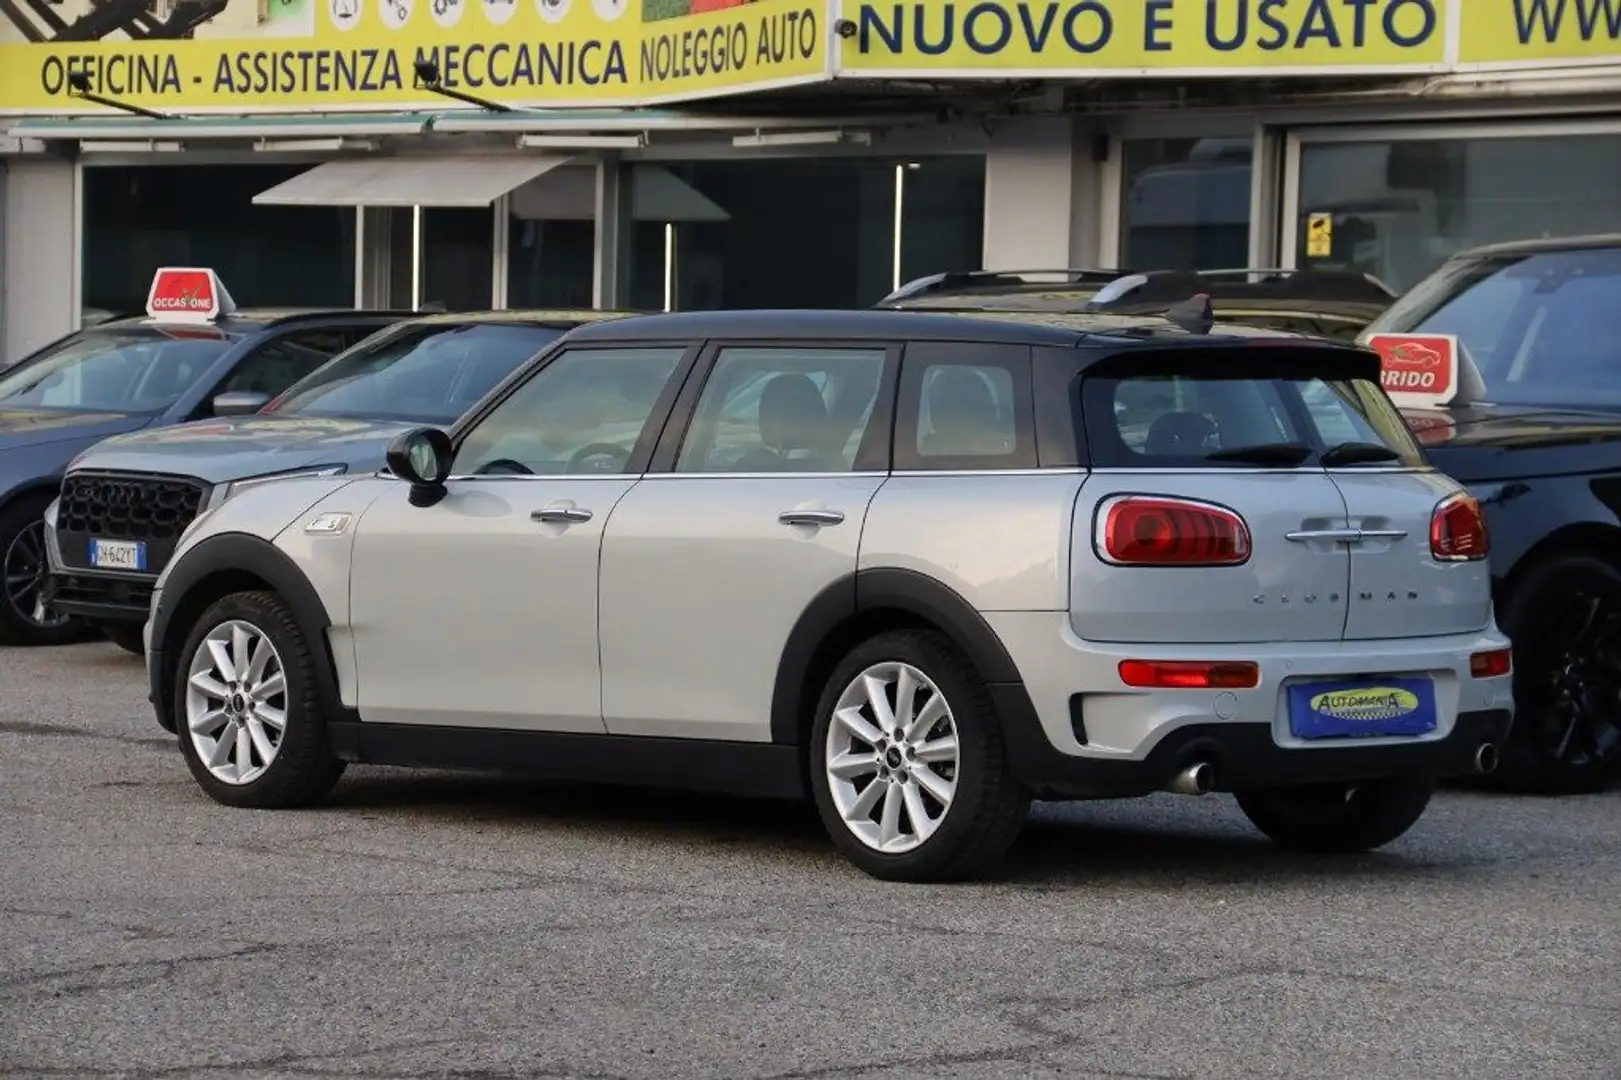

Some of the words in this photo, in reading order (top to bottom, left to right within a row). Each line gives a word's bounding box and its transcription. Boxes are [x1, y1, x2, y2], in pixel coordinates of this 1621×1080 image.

[639, 22, 748, 82] NOLEGGIO
[756, 8, 817, 65] AUTO
[858, 1, 1114, 54] NUOVO
[1144, 0, 1173, 51] E
[1205, 0, 1437, 51] USATO
[41, 54, 182, 95] OFFICINA
[213, 48, 401, 94] ASSISTENZA
[413, 40, 628, 88] MECCANICA
[153, 298, 211, 309] OCCASONE
